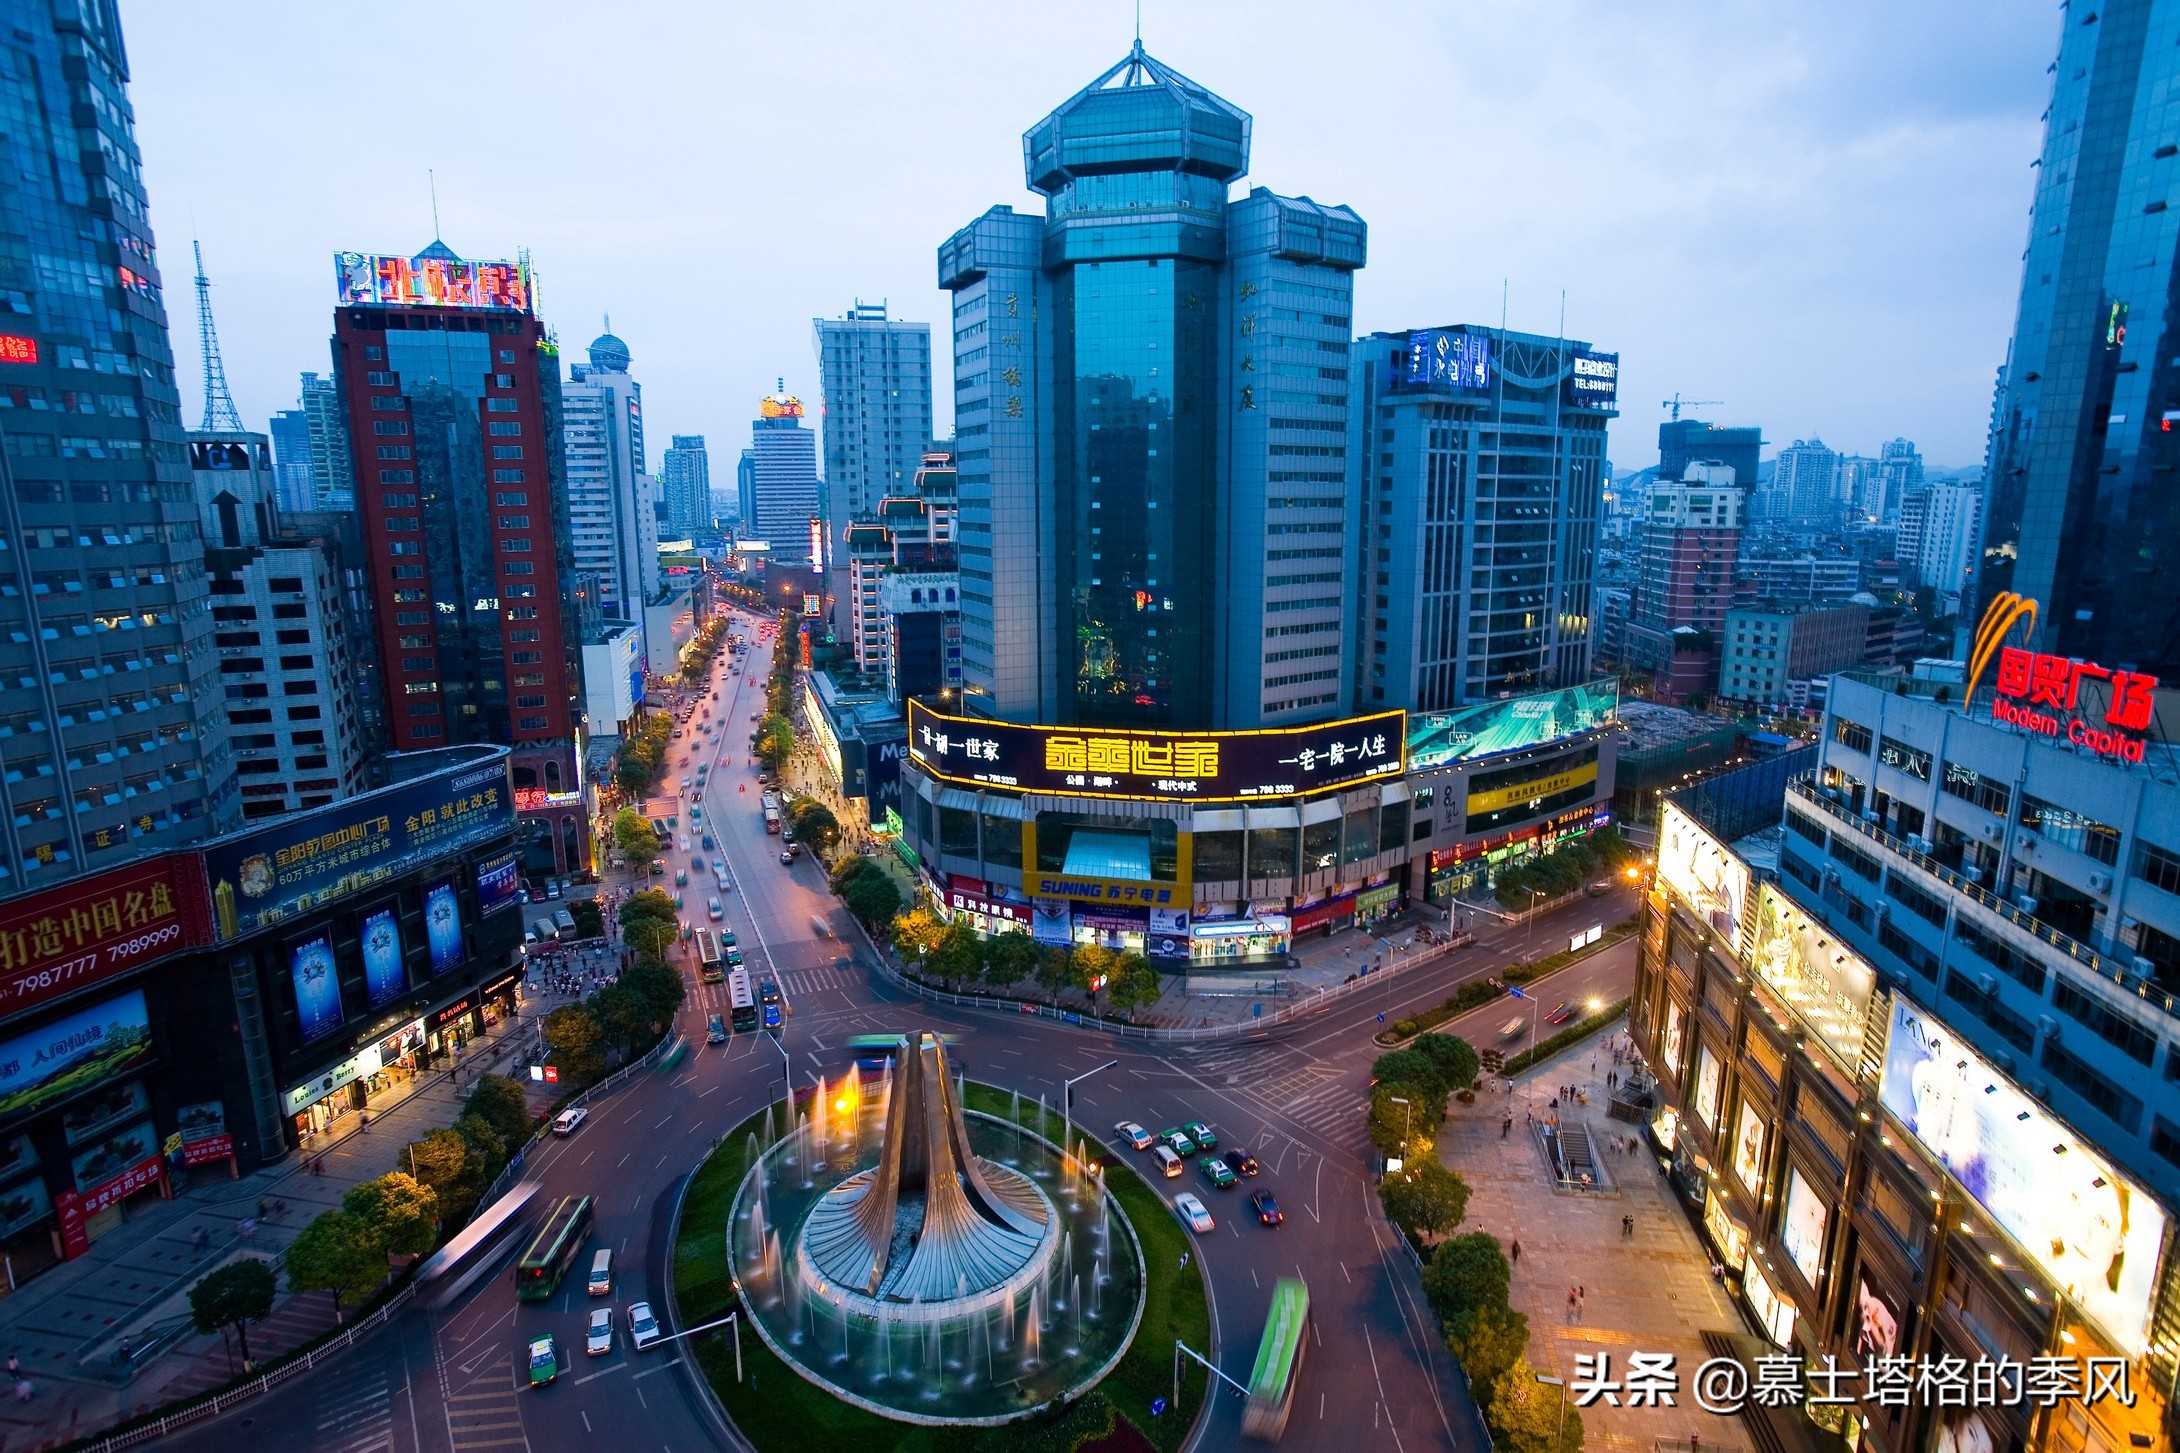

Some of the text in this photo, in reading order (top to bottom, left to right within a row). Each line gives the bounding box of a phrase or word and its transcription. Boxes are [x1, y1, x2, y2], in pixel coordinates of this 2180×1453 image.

[1997, 646, 2158, 731] 国贸广场
[1992, 697, 2146, 763] Modern Capital
[405, 788, 498, 832] 金阳 就此改变
[1040, 880, 1102, 897] SUNING
[1107, 886, 1171, 903] 苏宁电器
[107, 924, 180, 962] 7989999
[31, 1025, 104, 1068] 人间仙境
[336, 1064, 355, 1081] Berry
